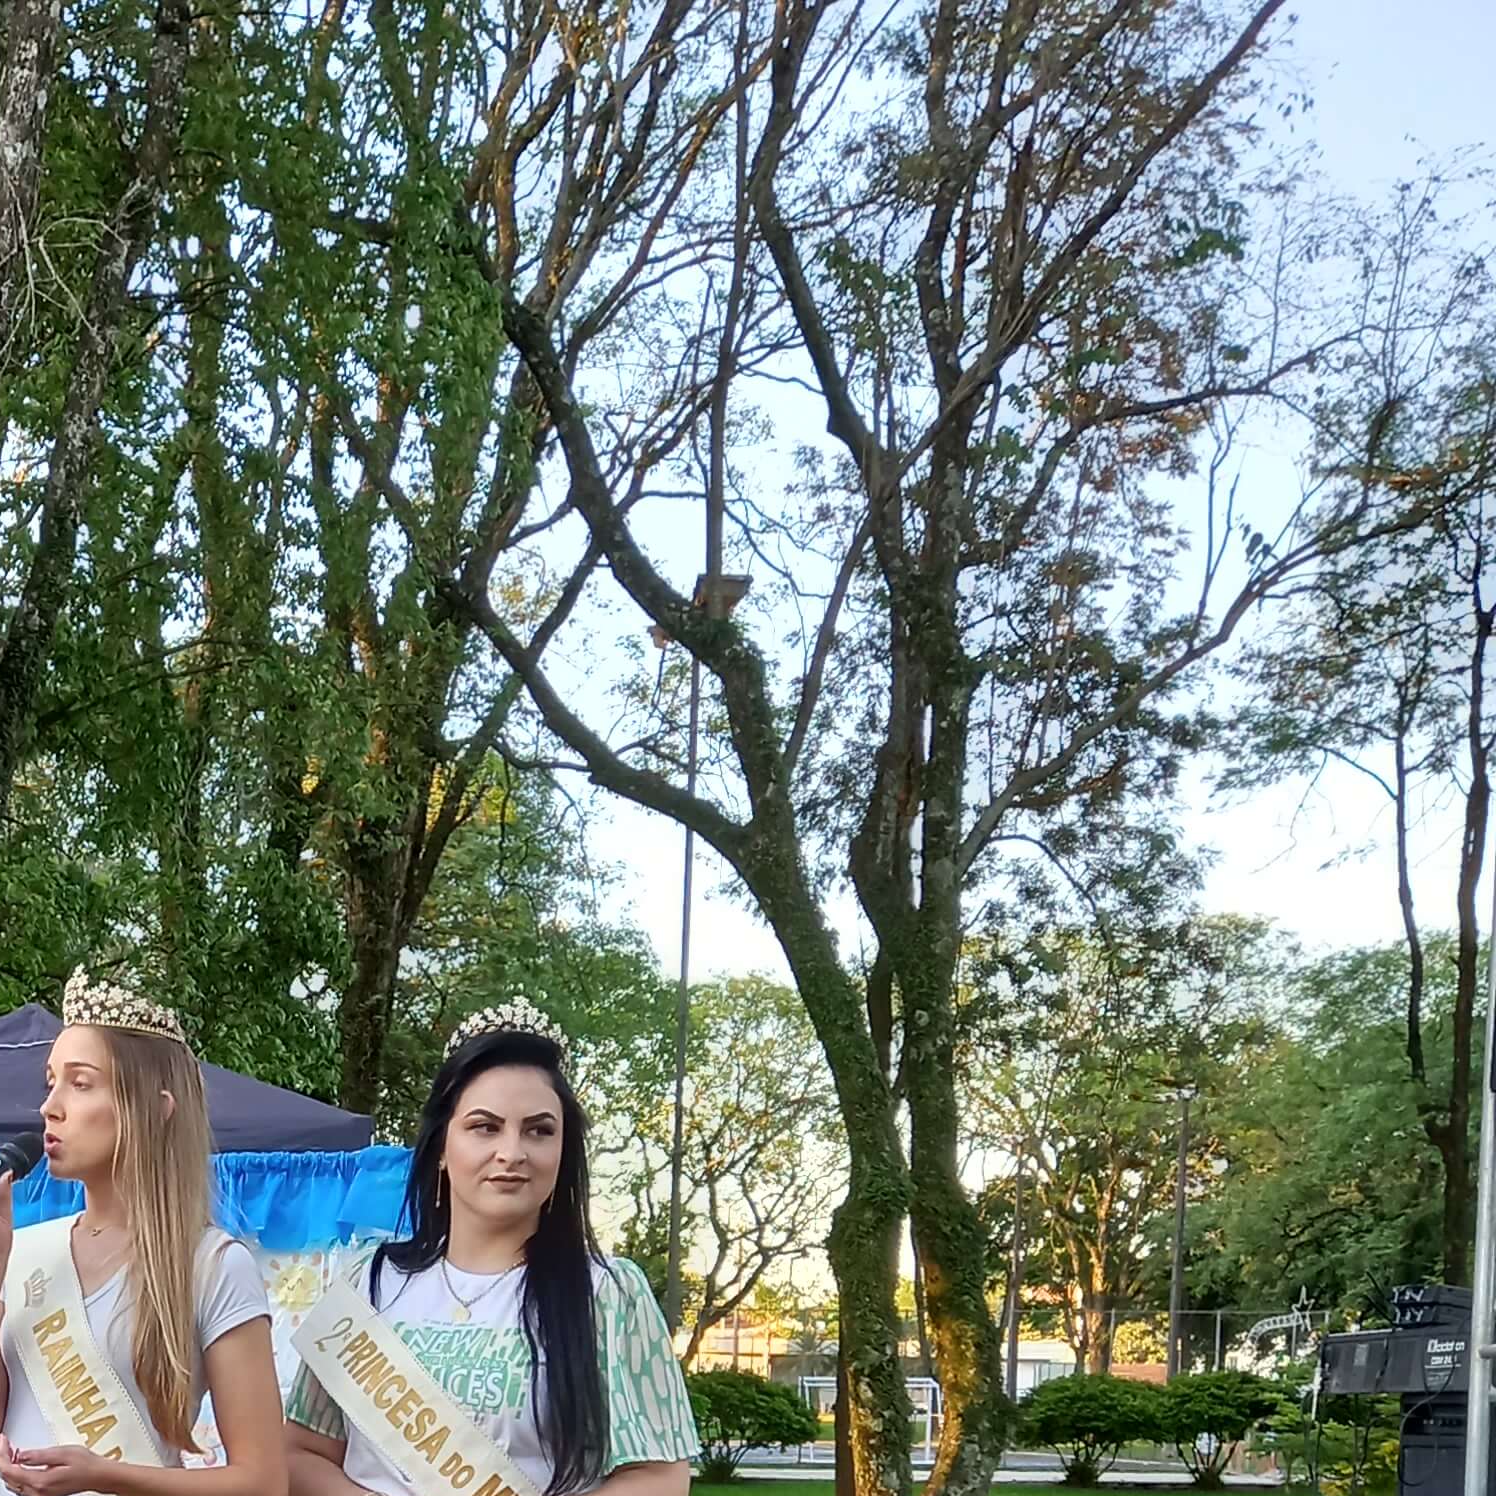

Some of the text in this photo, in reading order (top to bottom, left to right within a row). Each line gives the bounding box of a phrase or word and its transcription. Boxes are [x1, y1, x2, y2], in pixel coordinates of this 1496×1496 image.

[32, 1308, 119, 1448] RAINHA
[336, 1330, 452, 1465] PRINCESA
[439, 1451, 475, 1489] DO
